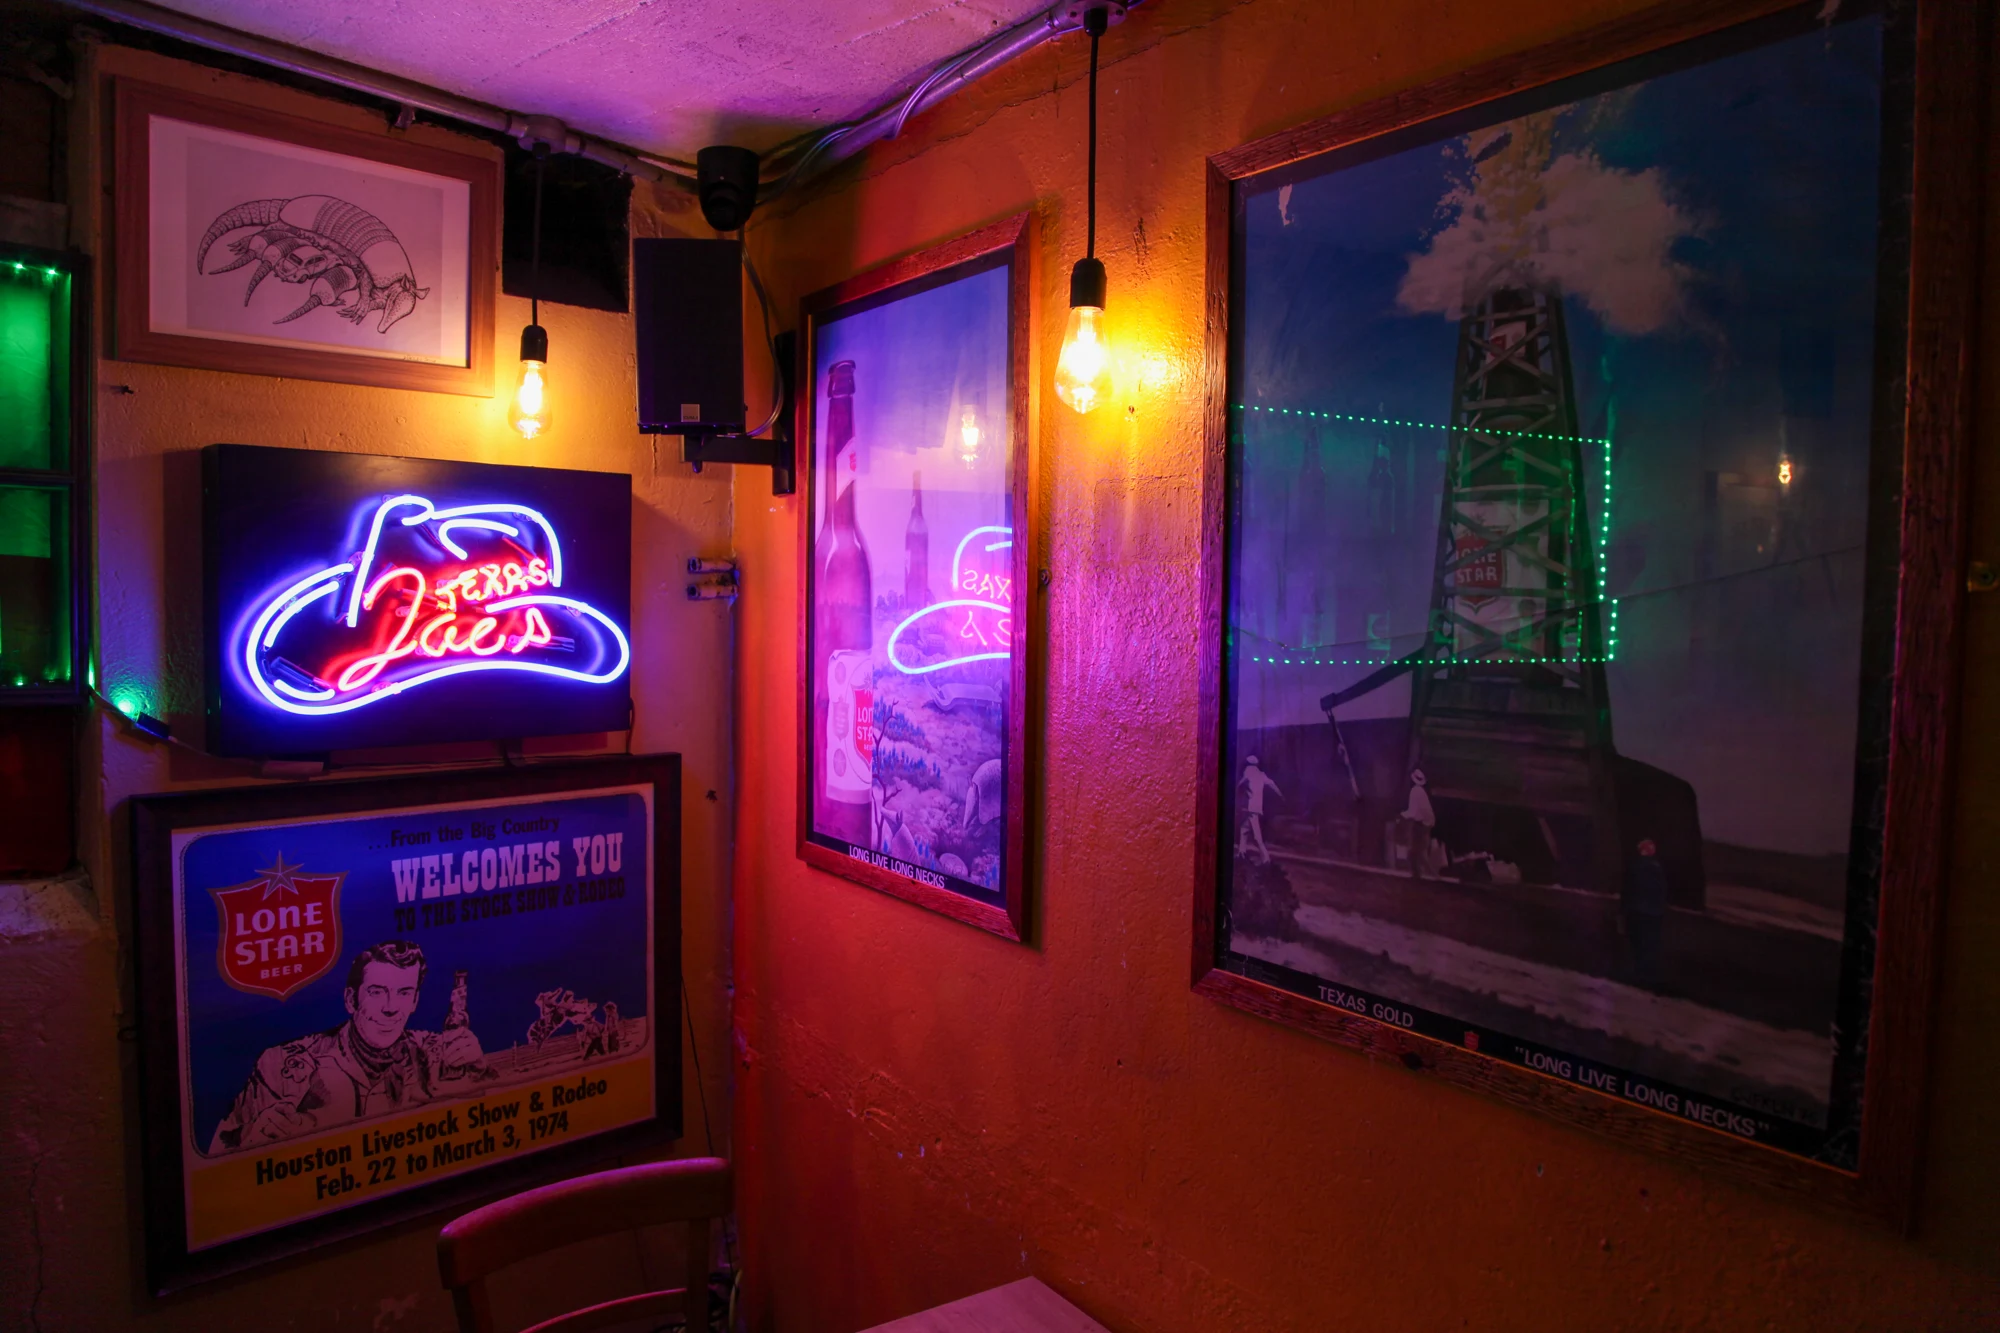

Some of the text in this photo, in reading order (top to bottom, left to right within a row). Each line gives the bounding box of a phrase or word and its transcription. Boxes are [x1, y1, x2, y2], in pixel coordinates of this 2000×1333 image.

[435, 557, 550, 611] TEXAS
[437, 825, 463, 843] the
[471, 820, 496, 841] Big
[502, 816, 560, 834] Country
[391, 832, 624, 903] WELCOMES YOU
[849, 844, 870, 863] LONG
[871, 851, 889, 870] LIVE
[890, 858, 914, 878] LONG
[235, 902, 324, 937] LONE
[394, 875, 625, 932] TO THE STOCK SHOW & RODEO
[235, 931, 326, 966] STAR
[260, 963, 303, 980] BEER
[1317, 985, 1415, 1028] TEXAS GOLD
[1577, 1064, 1618, 1094] LIVE
[1623, 1079, 1680, 1113] LONG
[256, 1076, 607, 1186] Houston Livestock Show & Rodeo
[316, 1111, 569, 1200] Feb. 22 to March 3, 1974
